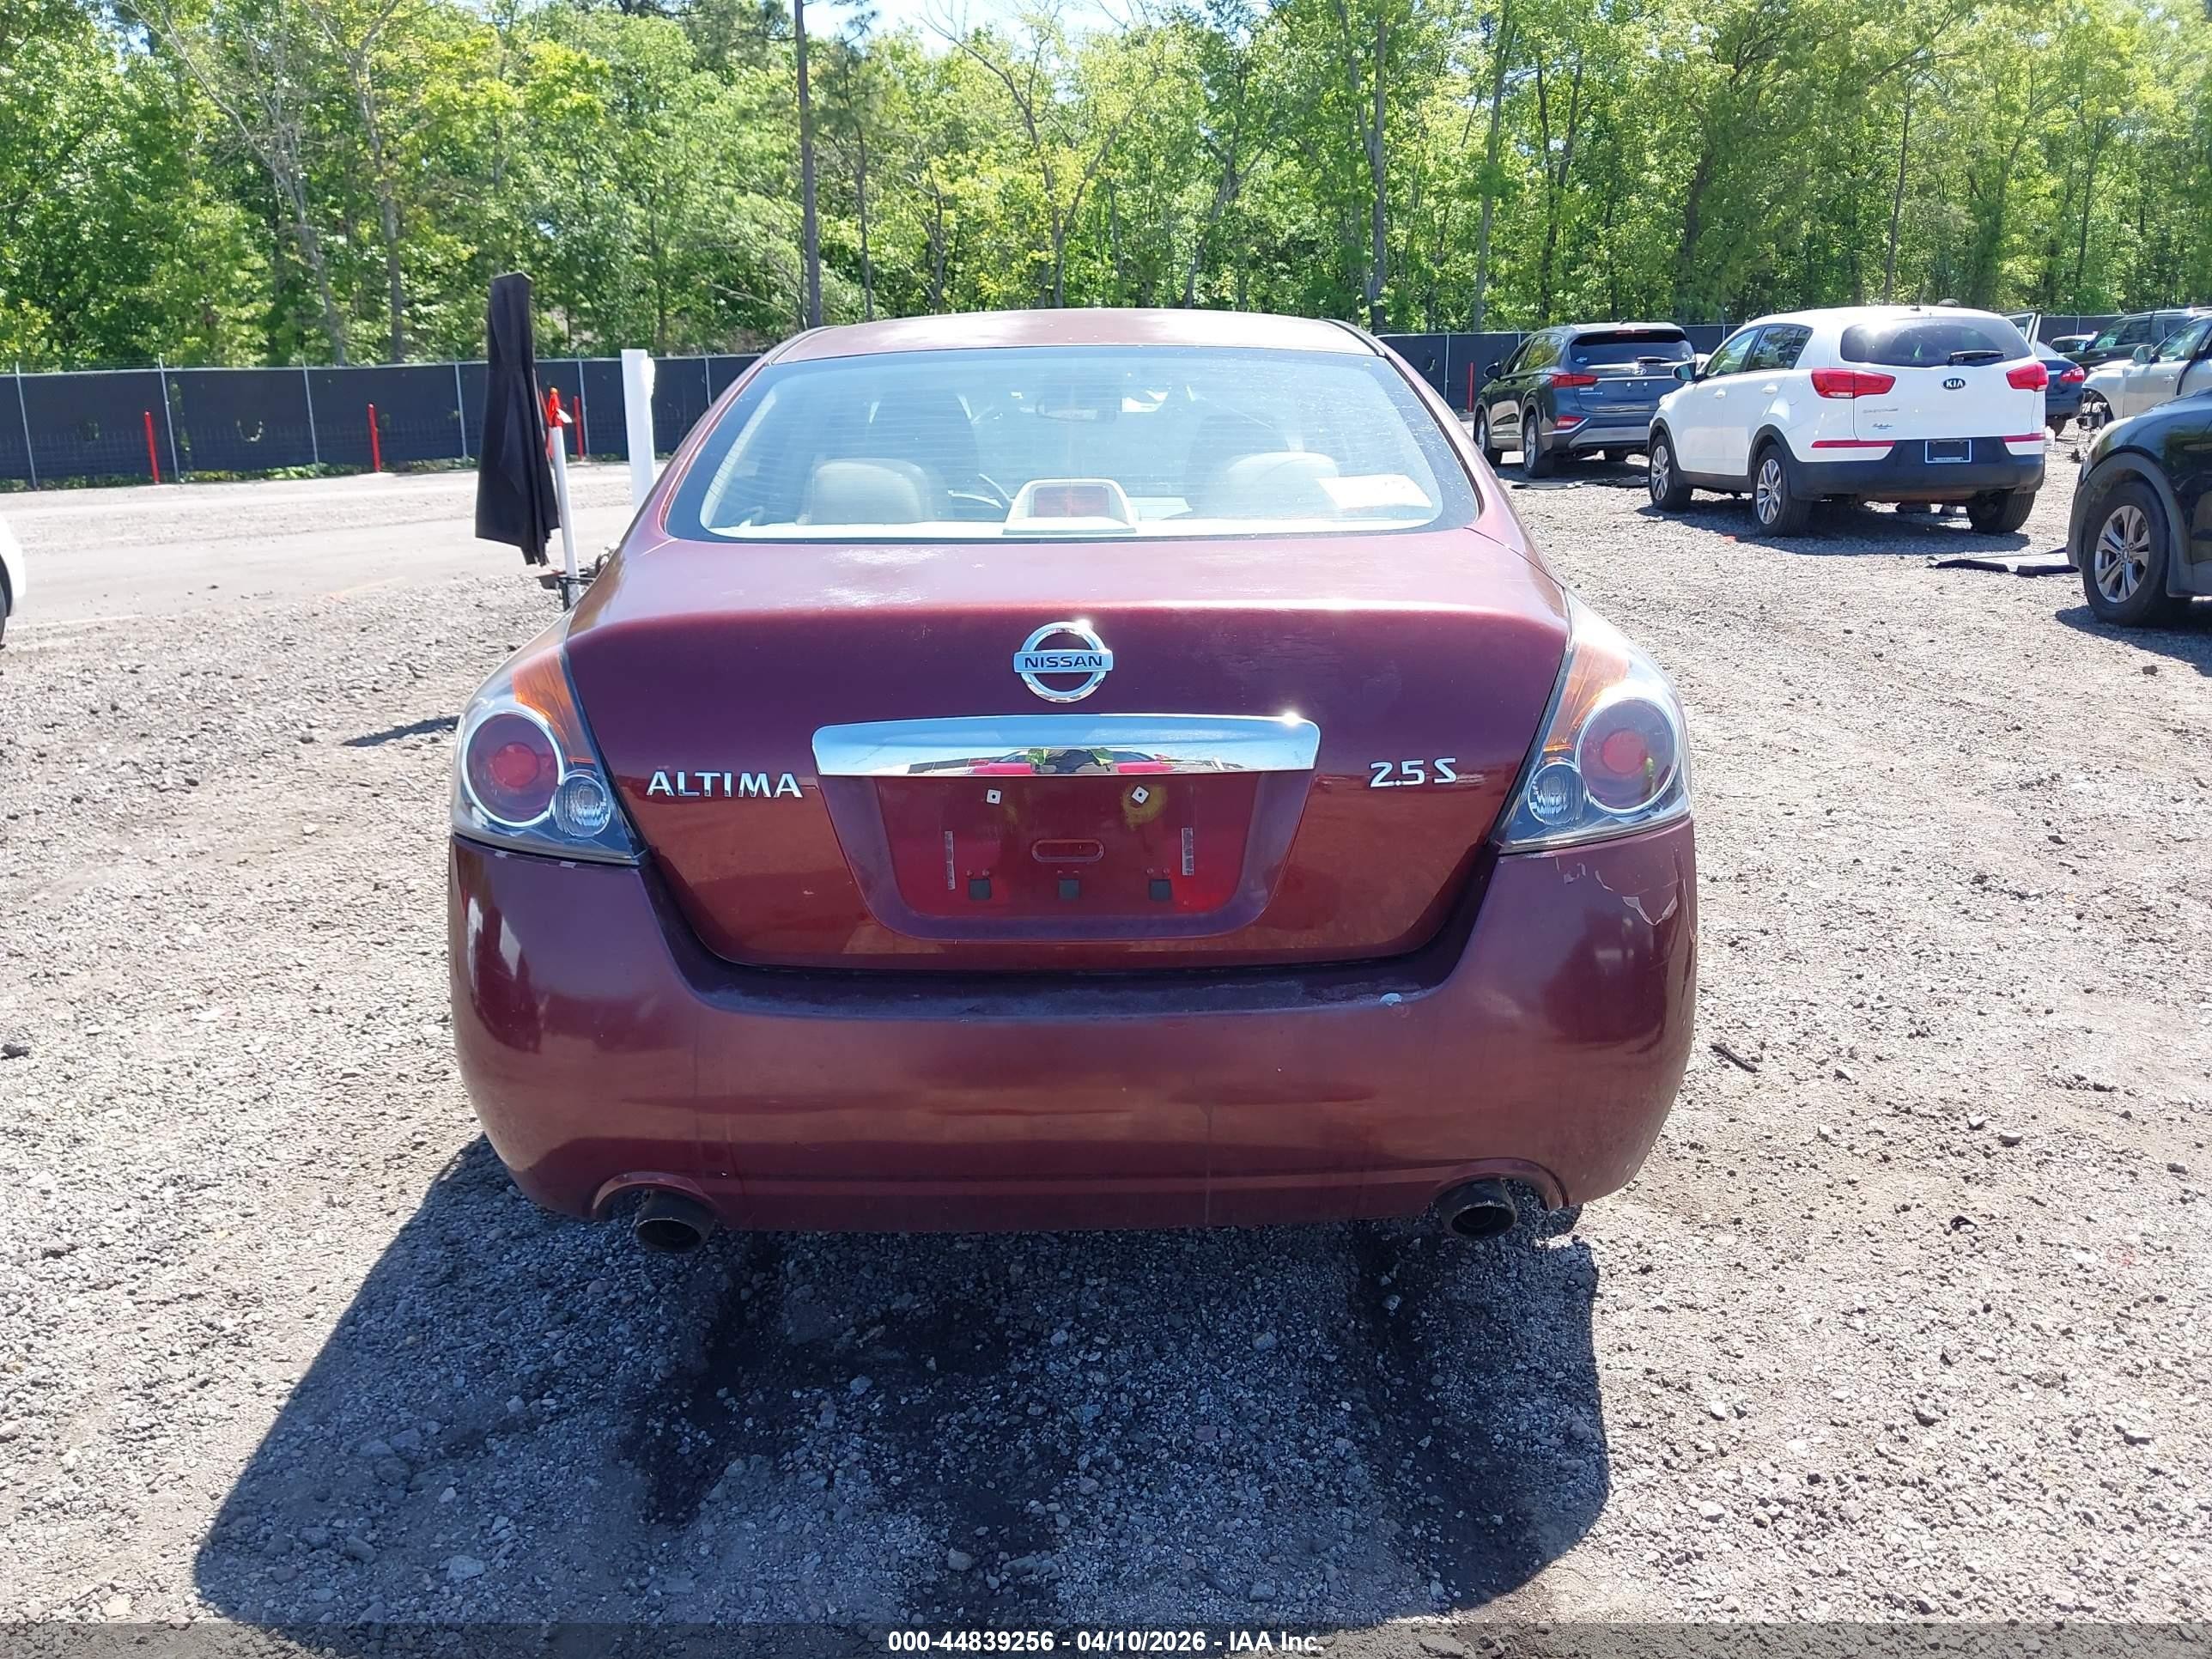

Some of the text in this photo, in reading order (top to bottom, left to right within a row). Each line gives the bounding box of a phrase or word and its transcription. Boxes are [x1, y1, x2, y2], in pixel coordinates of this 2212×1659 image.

[1946, 380, 1964, 388] KIA
[1024, 655, 1103, 668] NISSAN
[1370, 757, 1457, 788] 2.5 S
[646, 771, 804, 799] ALTIMA
